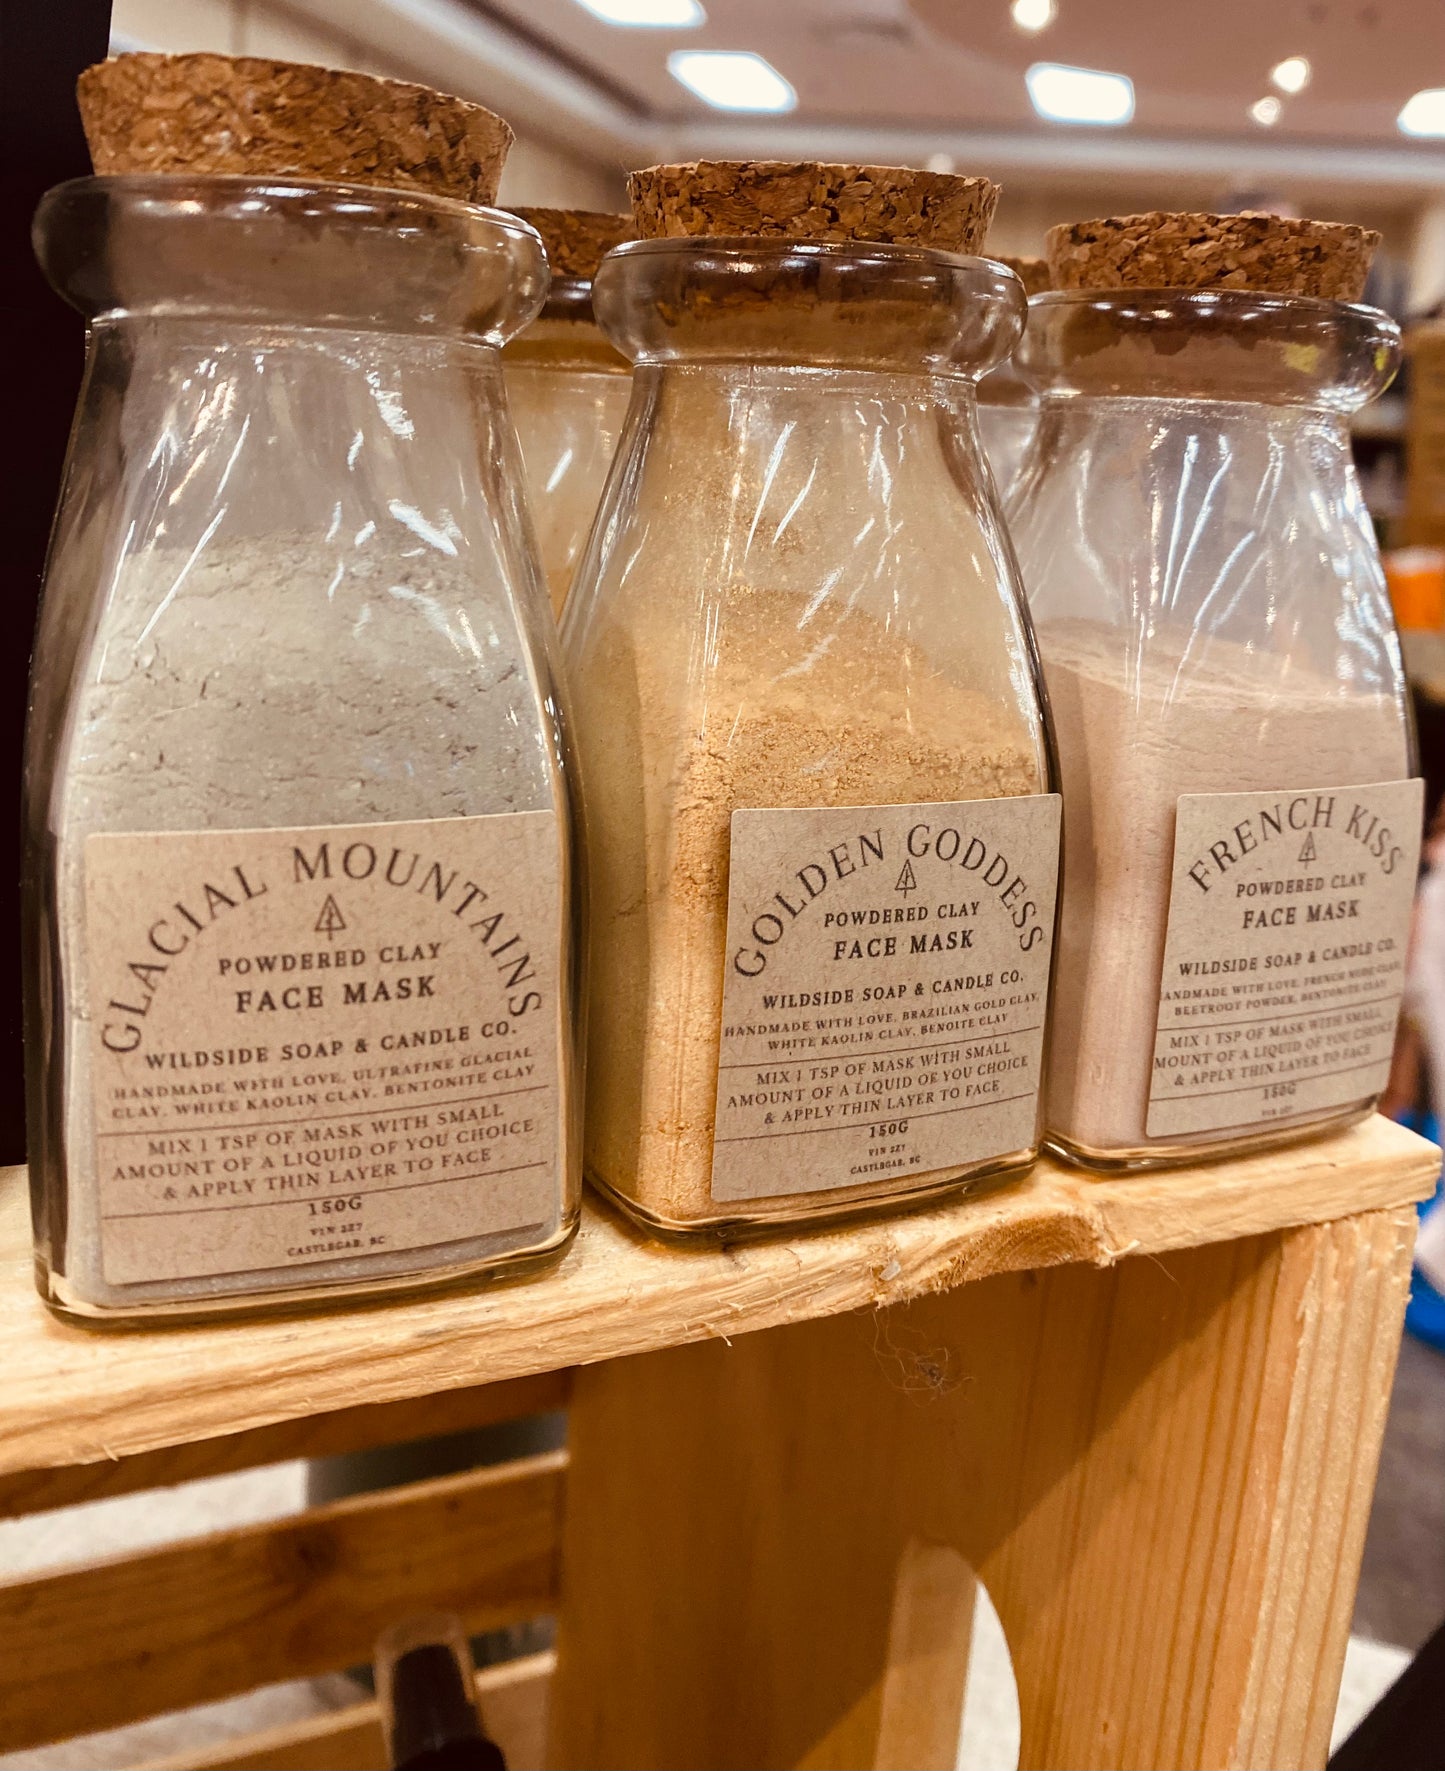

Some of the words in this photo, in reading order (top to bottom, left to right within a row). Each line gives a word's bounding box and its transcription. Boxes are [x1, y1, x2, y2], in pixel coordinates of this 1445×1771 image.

[1188, 796, 1335, 893] FRENCH
[1346, 804, 1403, 874] KISS
[734, 828, 884, 977] GOLDEN
[907, 824, 1044, 952] GODDESS
[1236, 877, 1324, 897] POWDERED
[1331, 872, 1366, 889] CLAY
[824, 906, 928, 927] POWDERED
[937, 901, 980, 919] CLAY
[1242, 907, 1296, 929] FACE
[1306, 900, 1359, 922] MASK
[101, 865, 267, 1053] GLACIAL
[292, 842, 542, 1017] MOUNTAINS
[219, 949, 365, 976] POWDERED
[380, 943, 442, 963] CLAY
[834, 937, 897, 960] FACE
[910, 929, 974, 954] MASK
[1179, 957, 1258, 976] WILDSIDE
[1264, 951, 1302, 969] SOAP
[1308, 951, 1316, 963] &
[1322, 942, 1373, 961] CANDLE
[236, 986, 324, 1013] FACE
[343, 976, 435, 1004] MASK
[763, 990, 854, 1009] WILDSIDE
[863, 984, 907, 1002] SOAP
[915, 983, 924, 996] &
[933, 972, 993, 994] CANDLE
[1000, 970, 1023, 984] CO.
[724, 1021, 811, 1037] HANDMADE
[816, 1017, 853, 1030] WITH
[902, 1004, 970, 1021] BRAZILIAN
[974, 998, 1006, 1012] GOLD
[768, 1037, 816, 1050] WHITE
[821, 1032, 873, 1046] KAOLIN
[979, 1013, 1008, 1026] CLAY
[1170, 1036, 1199, 1048] MIX
[1215, 1031, 1242, 1044] TSP
[1246, 1028, 1265, 1041] OF
[1269, 1023, 1305, 1037] MASK
[146, 1047, 269, 1070] WILDSIDE
[281, 1041, 343, 1062] SOAP
[355, 1039, 368, 1053] &
[381, 1026, 470, 1050] CANDLE
[481, 1021, 517, 1037] CO.
[757, 1071, 790, 1085] MIX
[809, 1066, 839, 1080] TSP
[845, 1063, 866, 1076] OF
[872, 1057, 915, 1073] MASK
[920, 1050, 960, 1066] WITH
[965, 1042, 1011, 1059] SMALL
[1154, 1052, 1213, 1069] MOUNT
[1217, 1050, 1237, 1062] OF
[1239, 1050, 1249, 1060] A
[114, 1082, 226, 1100] HANDMADE
[233, 1077, 284, 1092] WITH
[353, 1055, 455, 1081] ULTRAFINE
[461, 1047, 533, 1067] GLACIAL
[175, 1100, 239, 1115] WHITE
[246, 1094, 317, 1111] KAOLIN
[385, 1072, 488, 1095] BENTONITE
[493, 1064, 535, 1081] CLAY
[727, 1089, 805, 1108] AMOUNT
[811, 1086, 834, 1099] OF
[839, 1084, 849, 1096] A
[855, 1077, 912, 1095] LIQUID
[943, 1066, 972, 1081] YOU
[977, 1055, 1028, 1076] CHOICE
[1174, 1074, 1184, 1086] &
[1190, 1069, 1235, 1084] APPLY
[1241, 1063, 1273, 1078] THIN
[1279, 1055, 1318, 1072] LAYER
[764, 1112, 776, 1124] &
[782, 1105, 834, 1122] APPLY
[840, 1100, 880, 1115] THIN
[887, 1091, 934, 1109] LAYER
[940, 1087, 960, 1101] TO
[965, 1080, 1000, 1096] FACE
[149, 1138, 192, 1155] MIX
[219, 1134, 257, 1150] TSP
[265, 1131, 295, 1146] OF
[303, 1124, 363, 1143] MASK
[371, 1115, 428, 1133] WITH
[438, 1104, 504, 1125] SMALL
[869, 1120, 909, 1138] 150G
[113, 1160, 215, 1180] AMOUNT
[223, 1157, 253, 1173] OF
[261, 1156, 275, 1169] A
[283, 1146, 361, 1167] LIQUID
[370, 1140, 398, 1156] OF
[406, 1133, 449, 1151] YOU
[456, 1119, 534, 1144] CHOICE
[163, 1187, 177, 1199] &
[187, 1179, 256, 1198] APPLY
[266, 1173, 320, 1190] THIN
[329, 1164, 397, 1184] LAYER
[404, 1158, 433, 1173] TO
[441, 1148, 492, 1167] FACE
[308, 1196, 362, 1216] 150G
